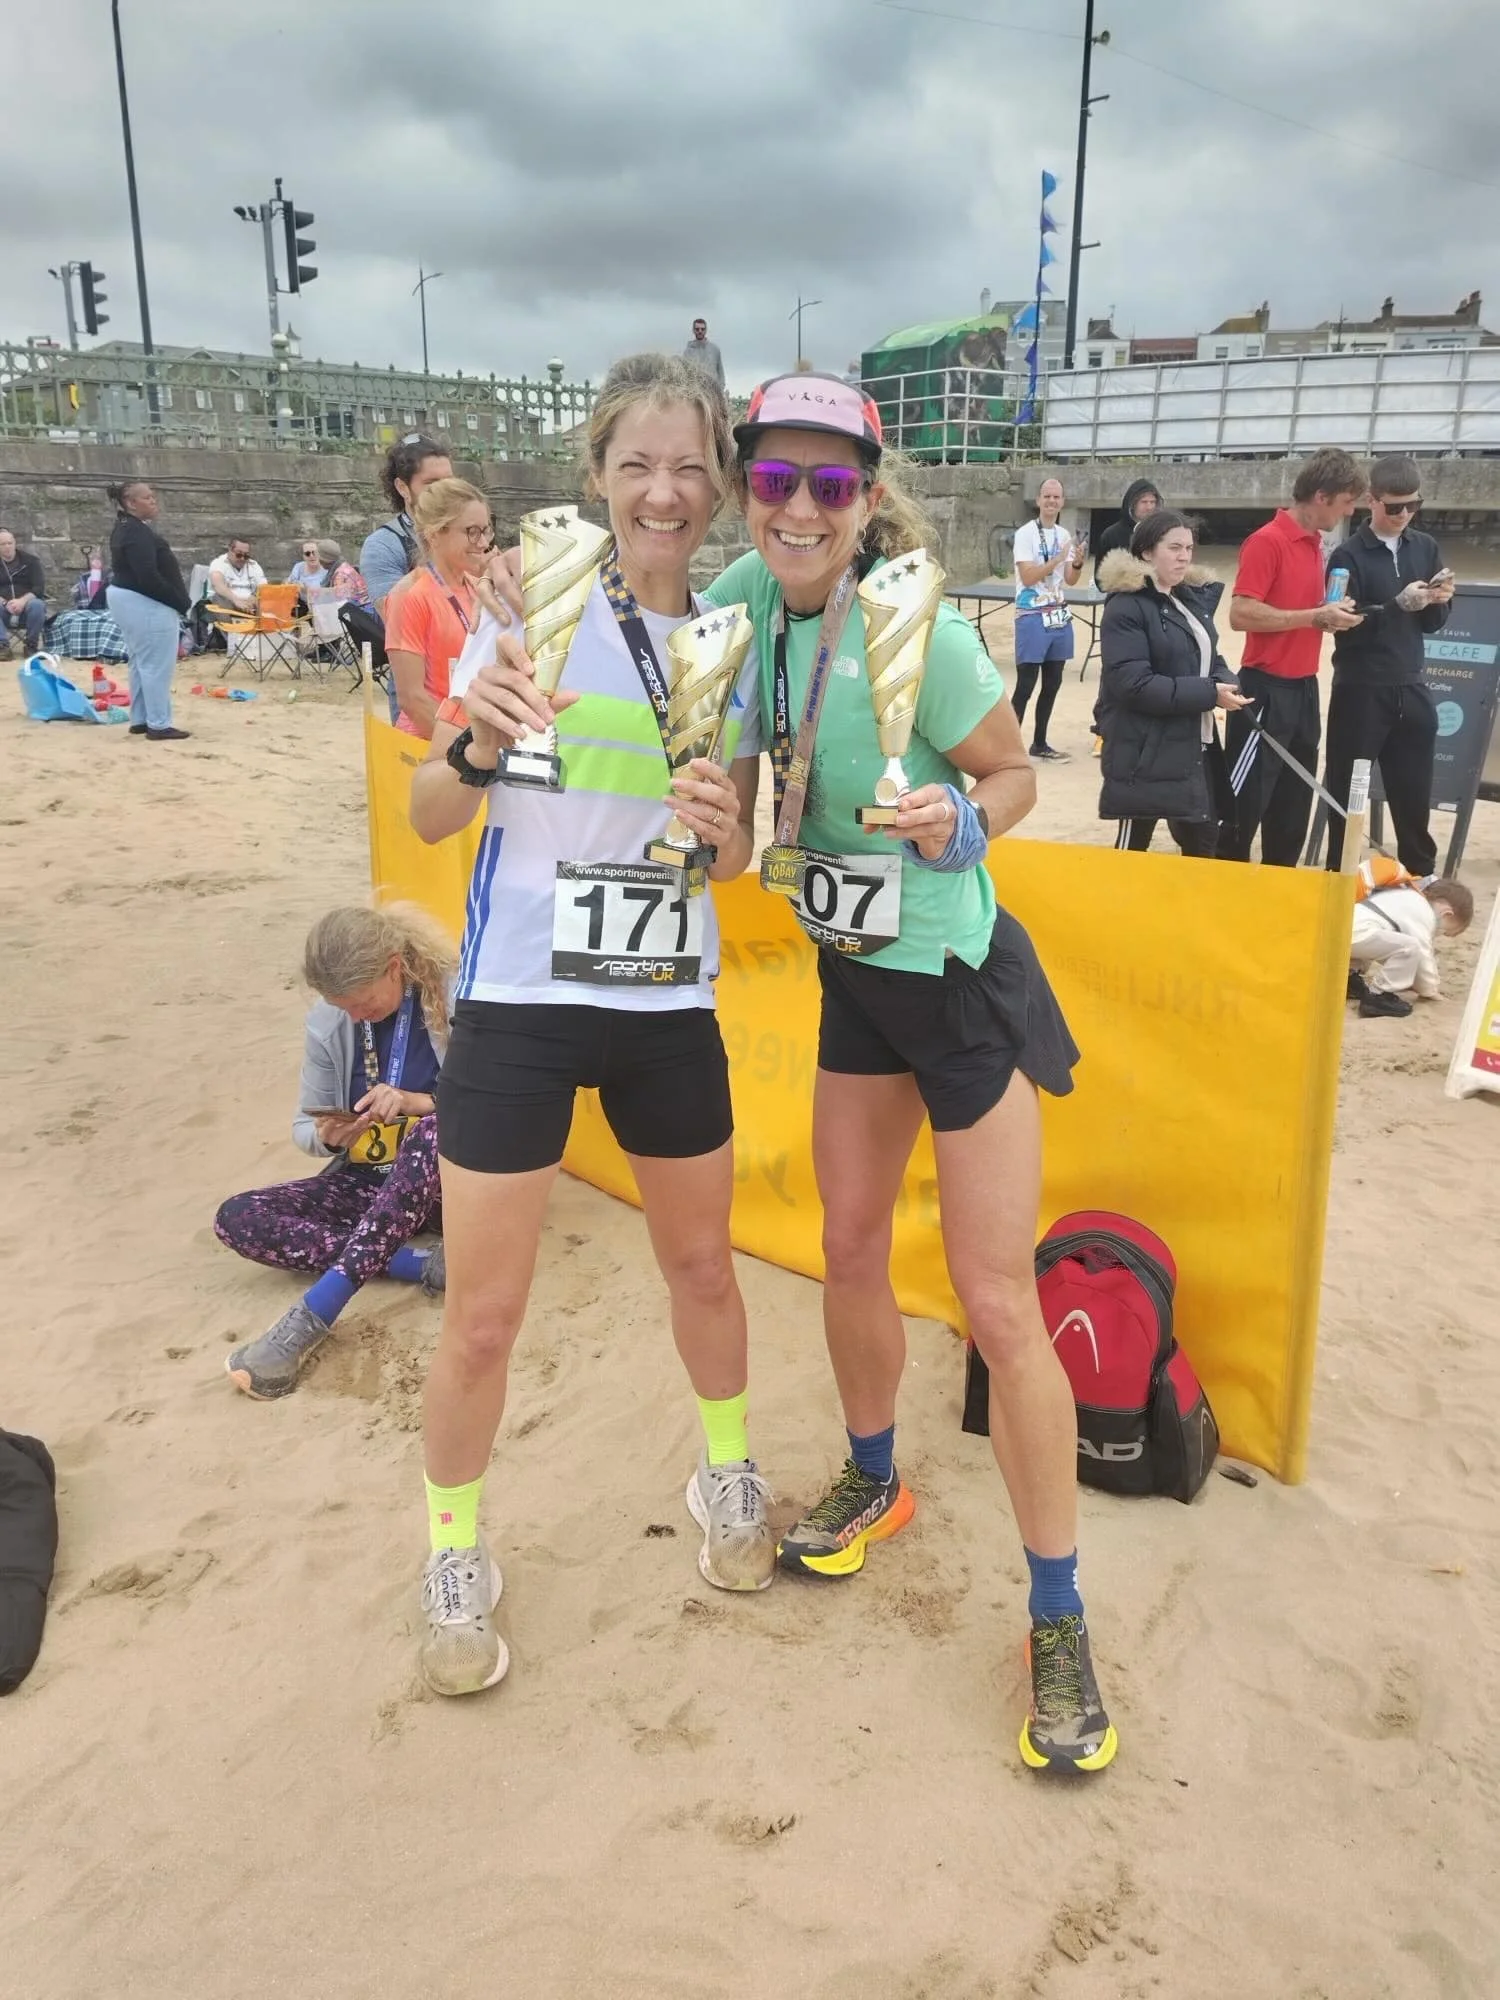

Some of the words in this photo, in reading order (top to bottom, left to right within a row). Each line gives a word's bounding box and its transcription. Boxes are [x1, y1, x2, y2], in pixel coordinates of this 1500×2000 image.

[1443, 629, 1471, 637] SAUNA
[1439, 645, 1480, 659] CAFE
[1426, 667, 1474, 679] RECHARGE
[1429, 682, 1453, 692] Coffee
[790, 864, 885, 930] 07
[574, 885, 688, 953] 171
[593, 960, 675, 976] sporting
[835, 1489, 889, 1549] TERREX
